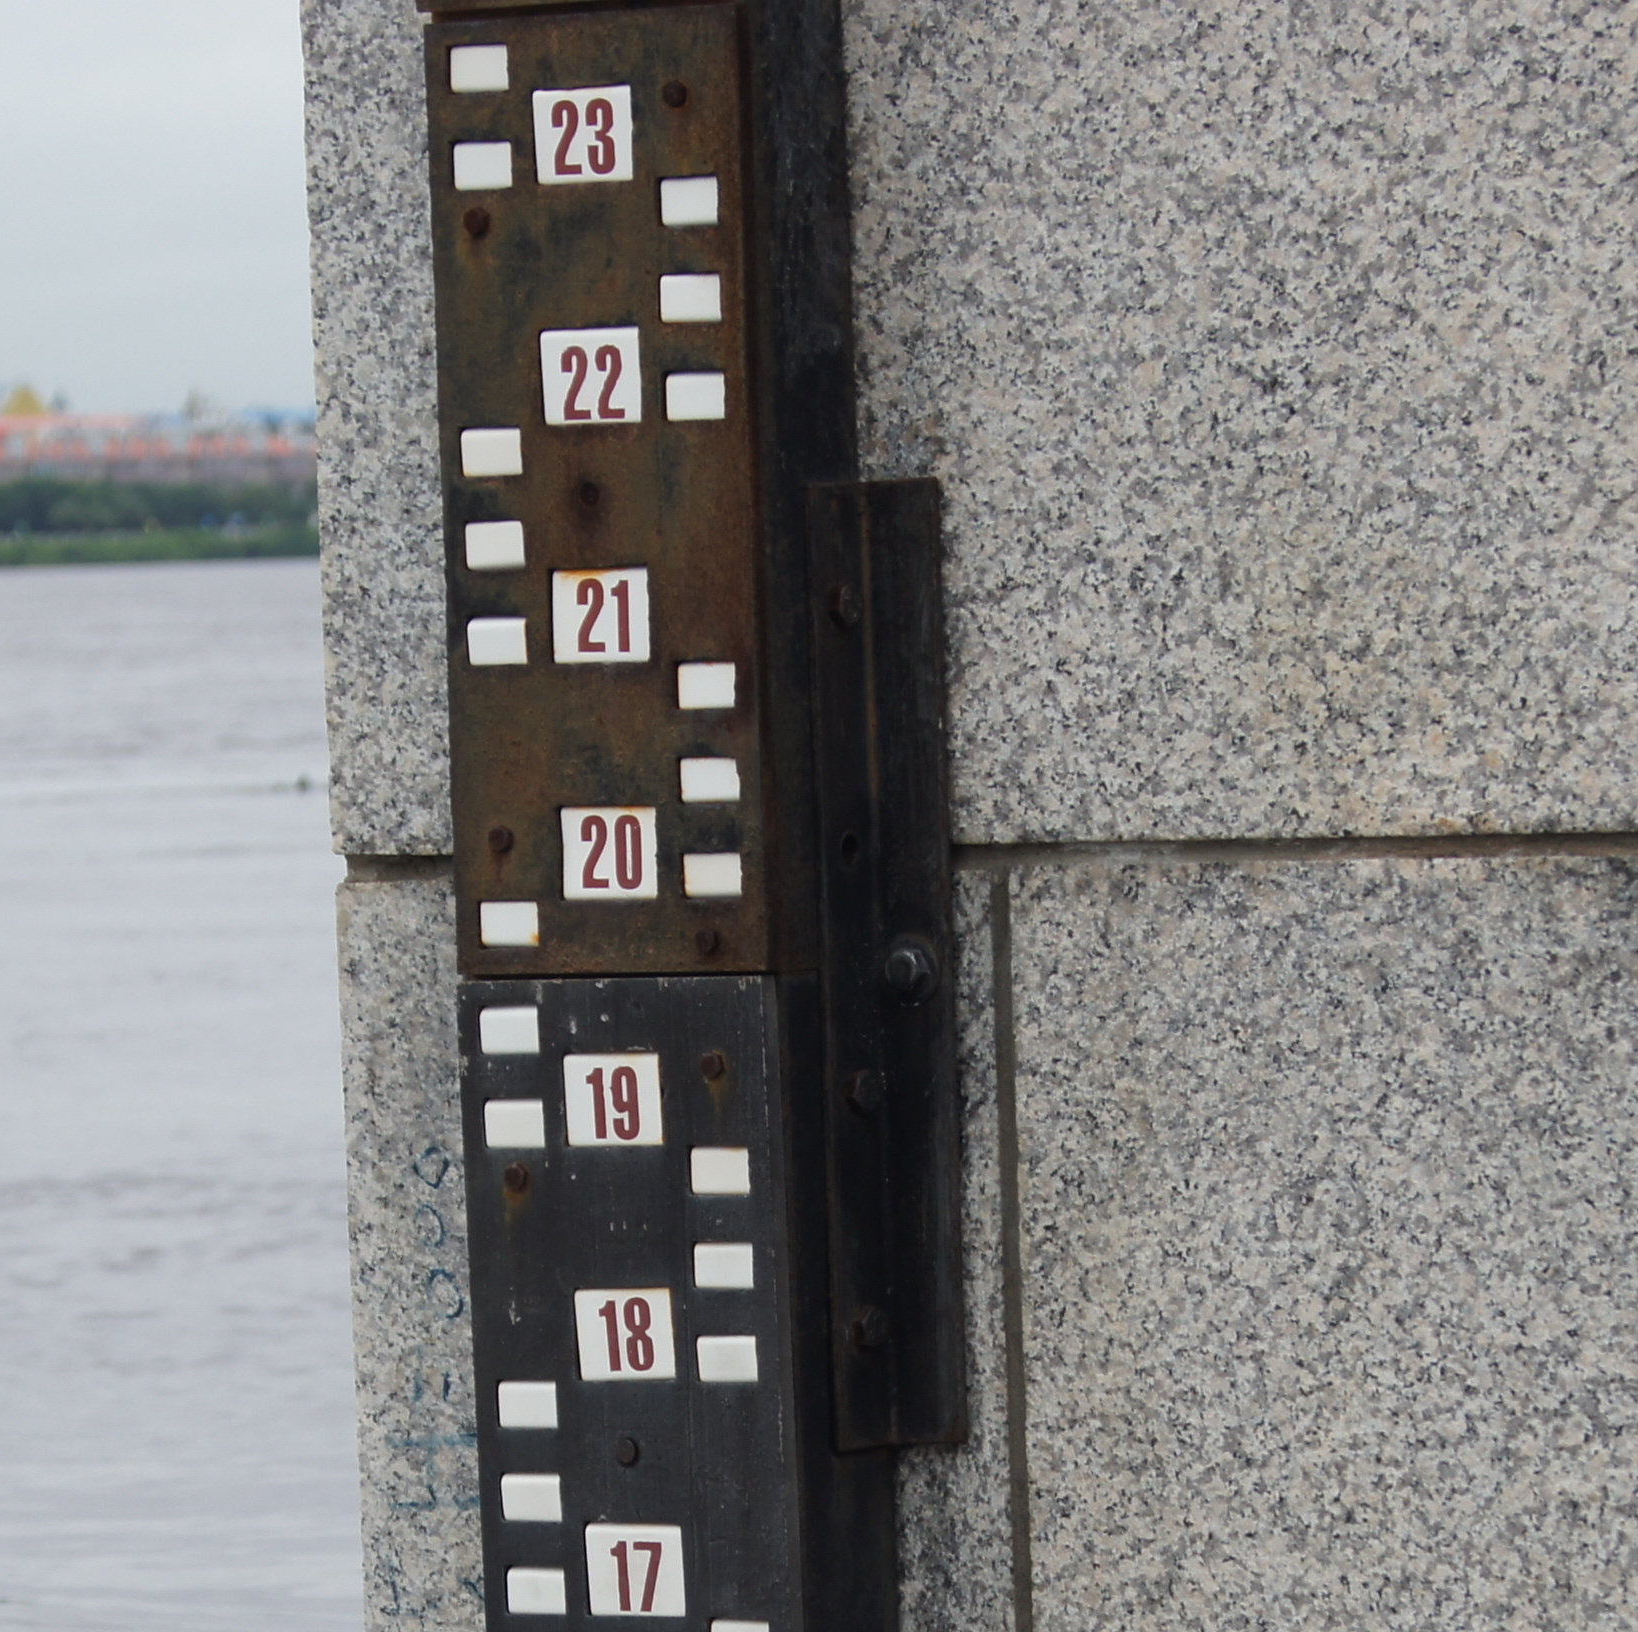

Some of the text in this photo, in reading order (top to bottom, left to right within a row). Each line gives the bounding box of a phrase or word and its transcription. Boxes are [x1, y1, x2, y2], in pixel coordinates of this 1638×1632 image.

[553, 99, 617, 176] 23
[563, 346, 627, 421] 22
[575, 579, 631, 653] 21
[580, 816, 644, 890] 20
[586, 1065, 640, 1141] 19
[598, 1297, 655, 1373] 18
[611, 1540, 662, 1613] 17
